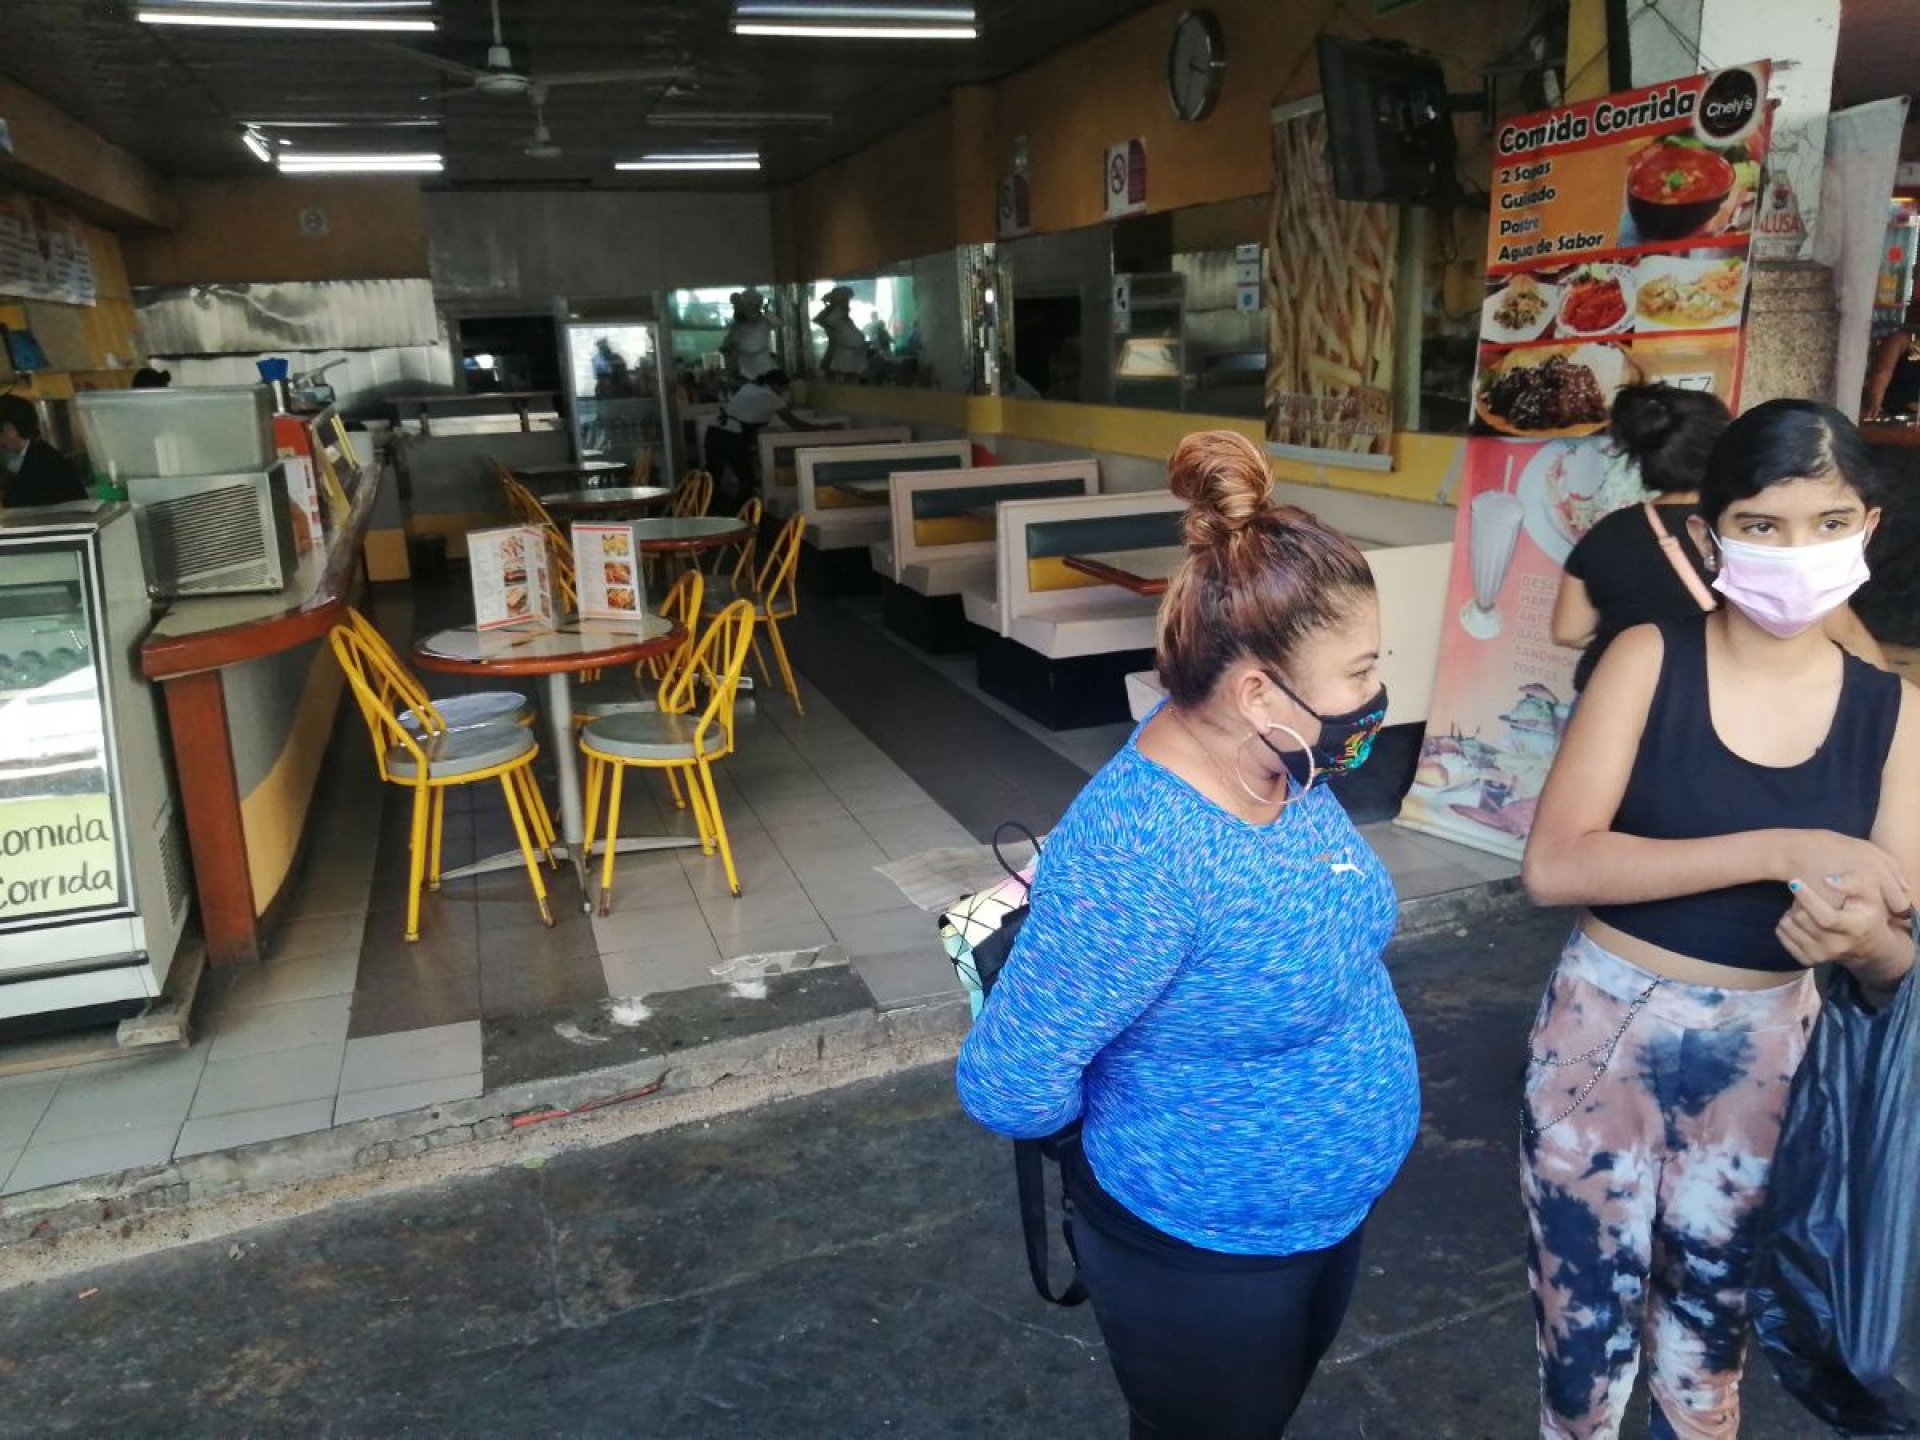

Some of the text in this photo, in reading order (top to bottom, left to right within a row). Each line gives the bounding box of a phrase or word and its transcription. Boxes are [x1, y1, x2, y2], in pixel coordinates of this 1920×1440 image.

[1499, 88, 1696, 154] Comida Corrida
[1501, 170, 1510, 183] 2
[1537, 238, 1552, 254] de
[1558, 232, 1604, 250] Sabor
[0, 812, 109, 856] omida
